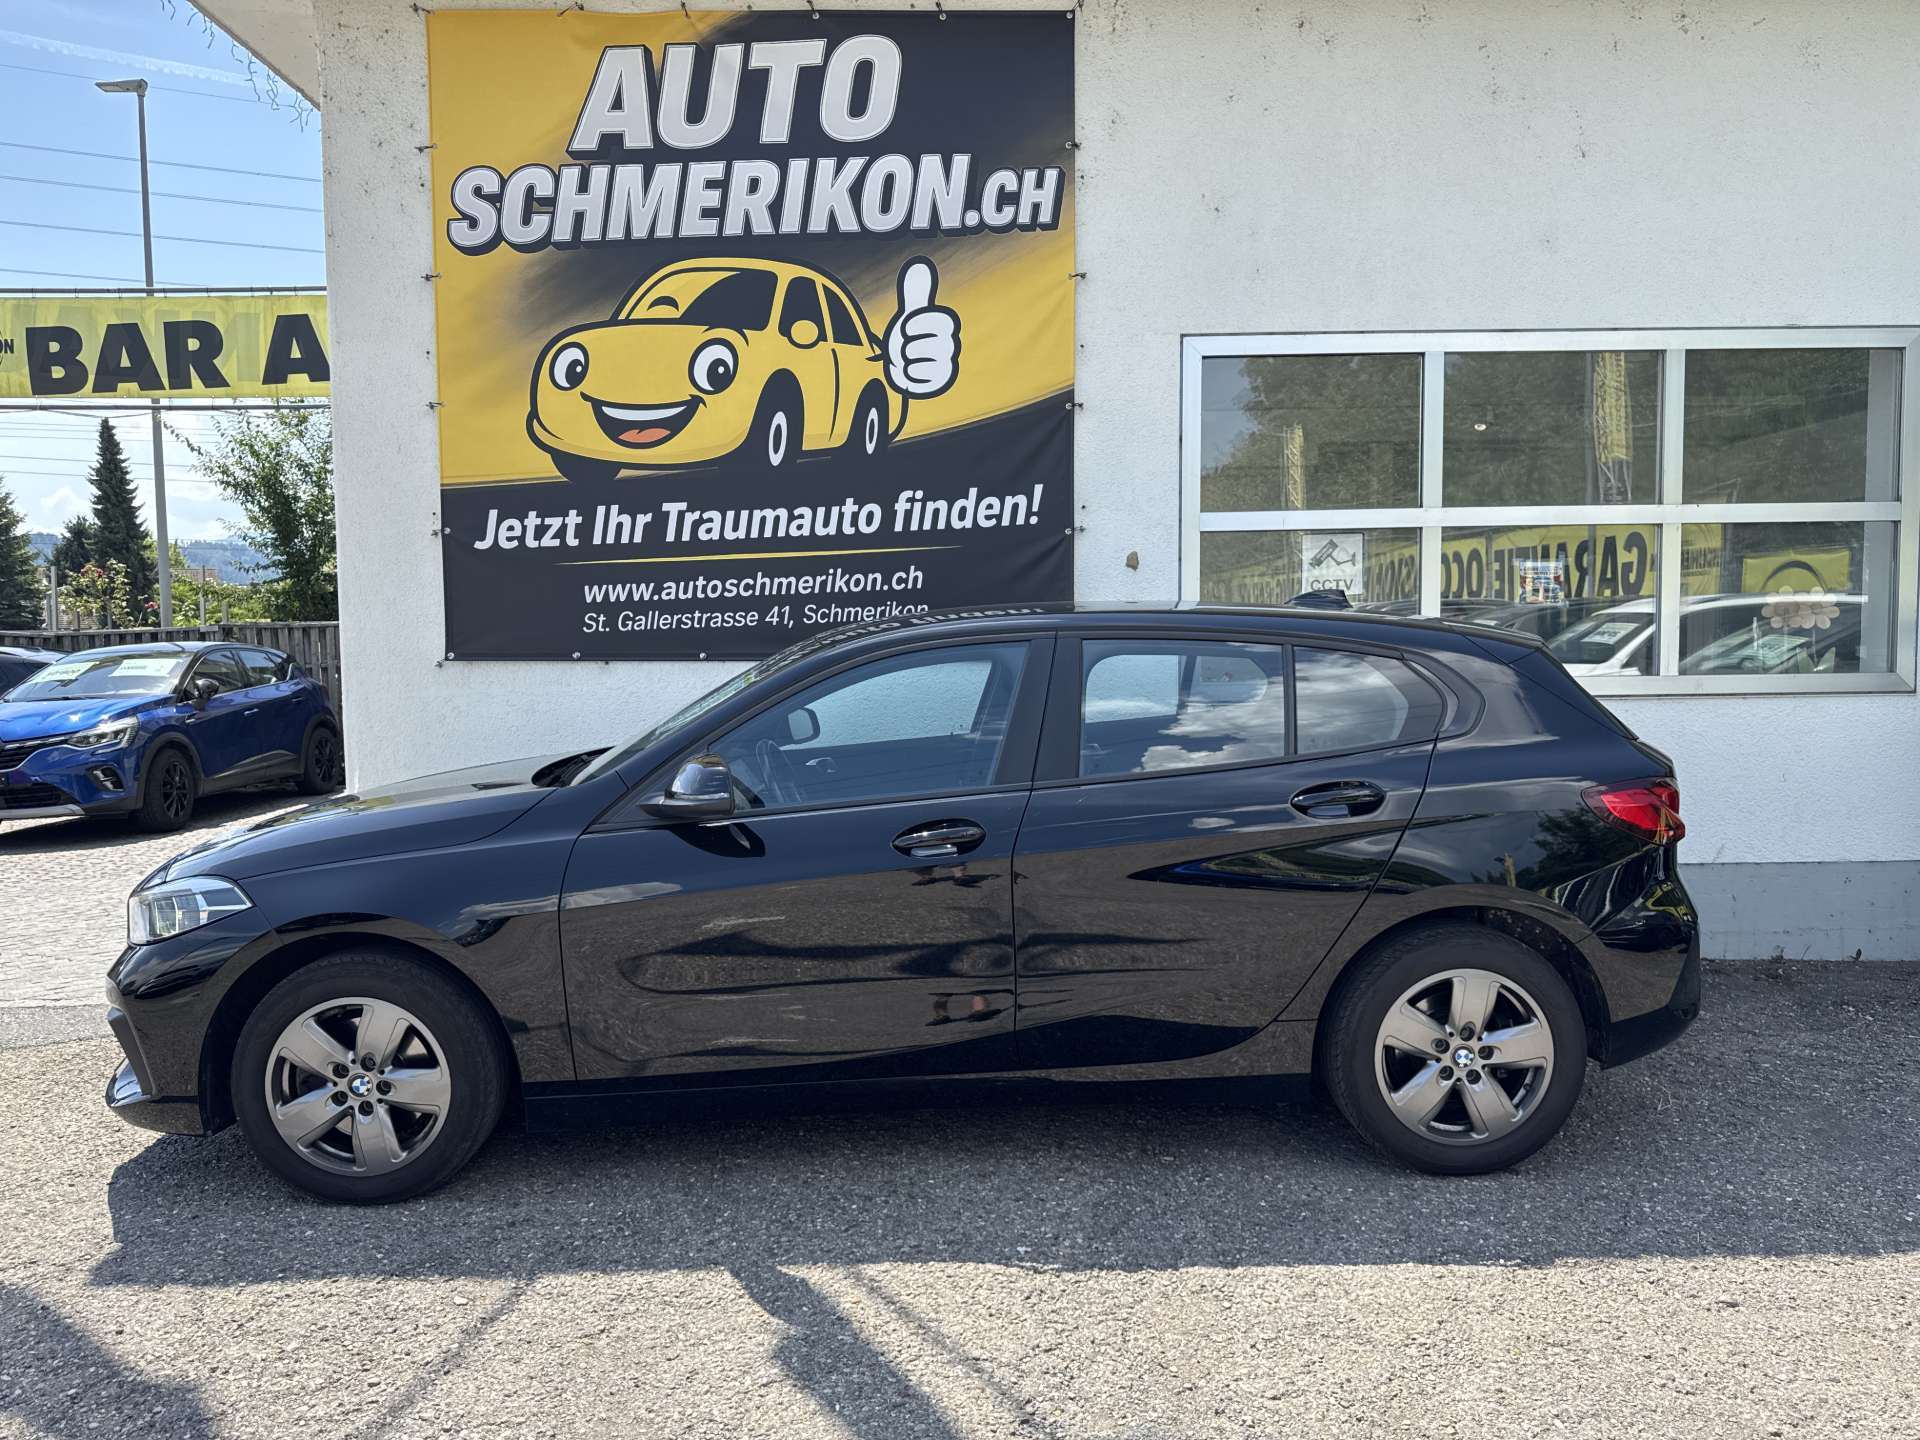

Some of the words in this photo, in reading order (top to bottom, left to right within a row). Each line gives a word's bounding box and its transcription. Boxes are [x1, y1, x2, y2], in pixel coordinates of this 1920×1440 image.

[569, 34, 903, 152] AUTO
[447, 153, 1061, 249] SCHMERIKON.CH
[25, 320, 231, 395] BAR
[473, 508, 582, 551] Jetzt
[592, 504, 652, 545] Ihr
[661, 496, 882, 543] Traumauto
[893, 483, 1045, 532] finden!
[582, 612, 610, 633] St.
[617, 609, 759, 632] Gallerstrasse
[764, 605, 794, 628] 41,
[802, 600, 929, 625] Schmerikon
[583, 566, 925, 603] www.autoschmerikon.ch
[1310, 578, 1354, 592] CCTV
